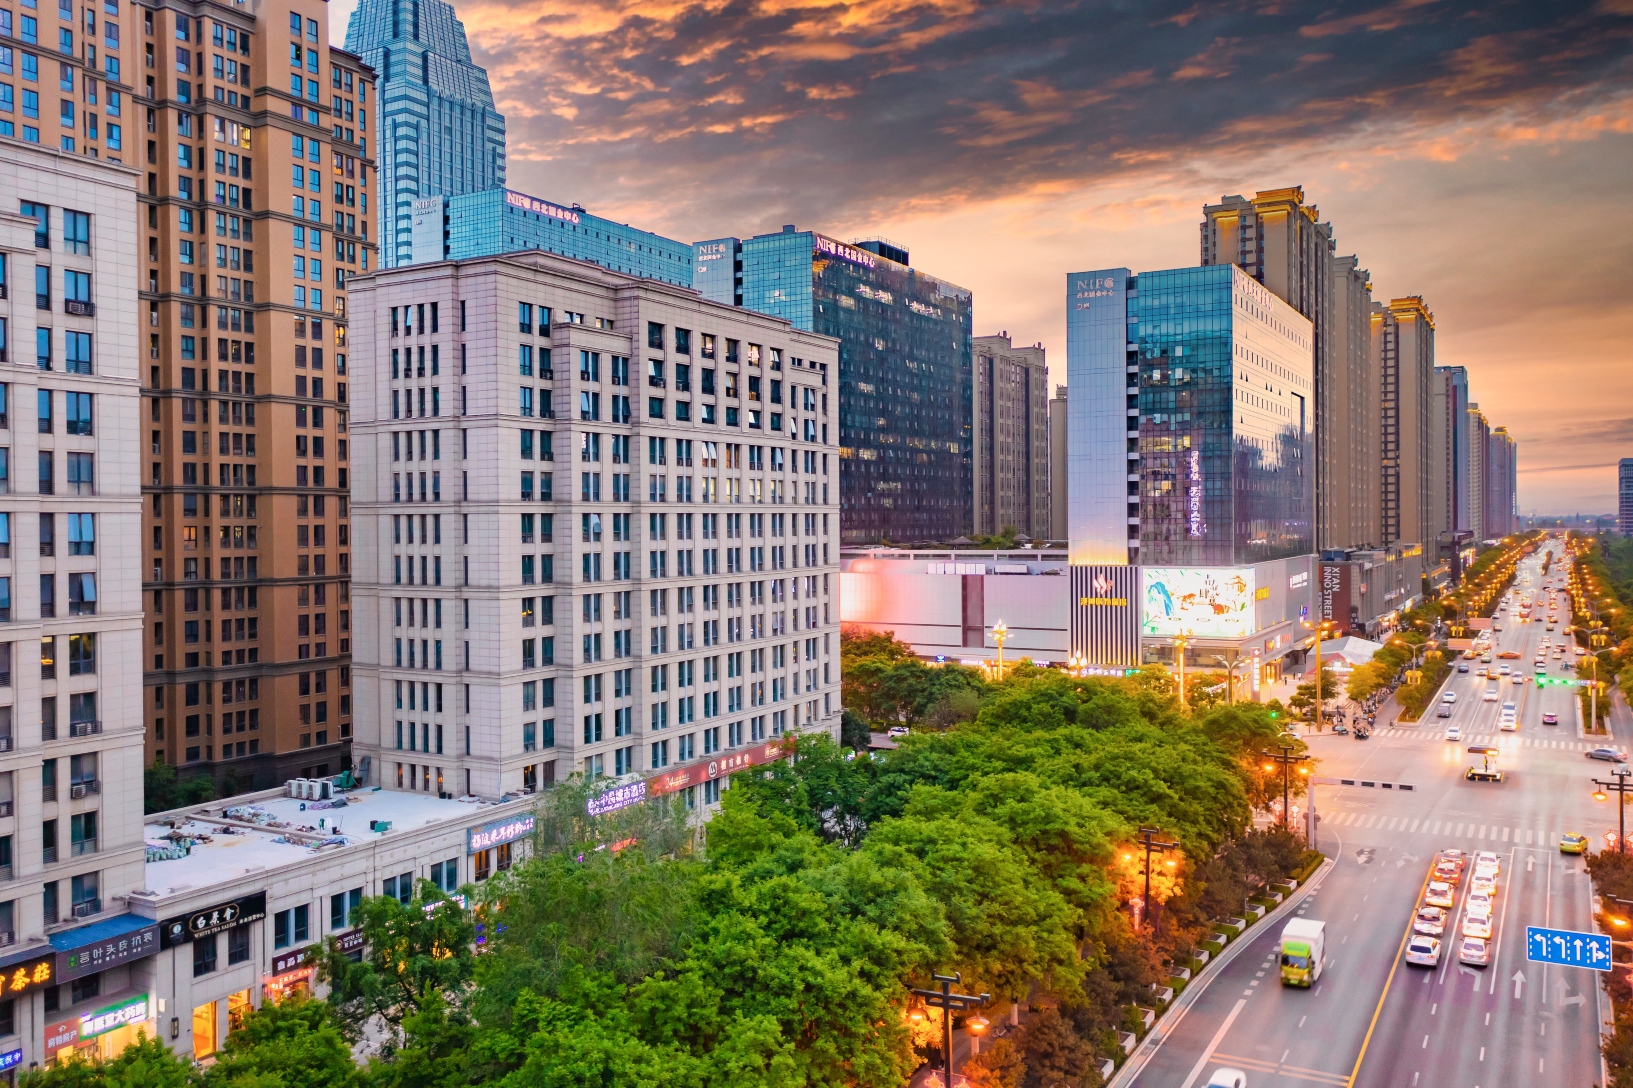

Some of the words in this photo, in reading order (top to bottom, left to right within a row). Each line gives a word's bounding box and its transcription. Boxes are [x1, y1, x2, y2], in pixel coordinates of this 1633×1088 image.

[837, 246, 876, 268] 西北国金中心
[1323, 566, 1332, 588] INNO
[1331, 566, 1340, 592] XI'AN
[1323, 589, 1333, 620] STREET
[194, 930, 211, 938] WHITE
[211, 926, 221, 934] TEA
[221, 921, 237, 930] SALON
